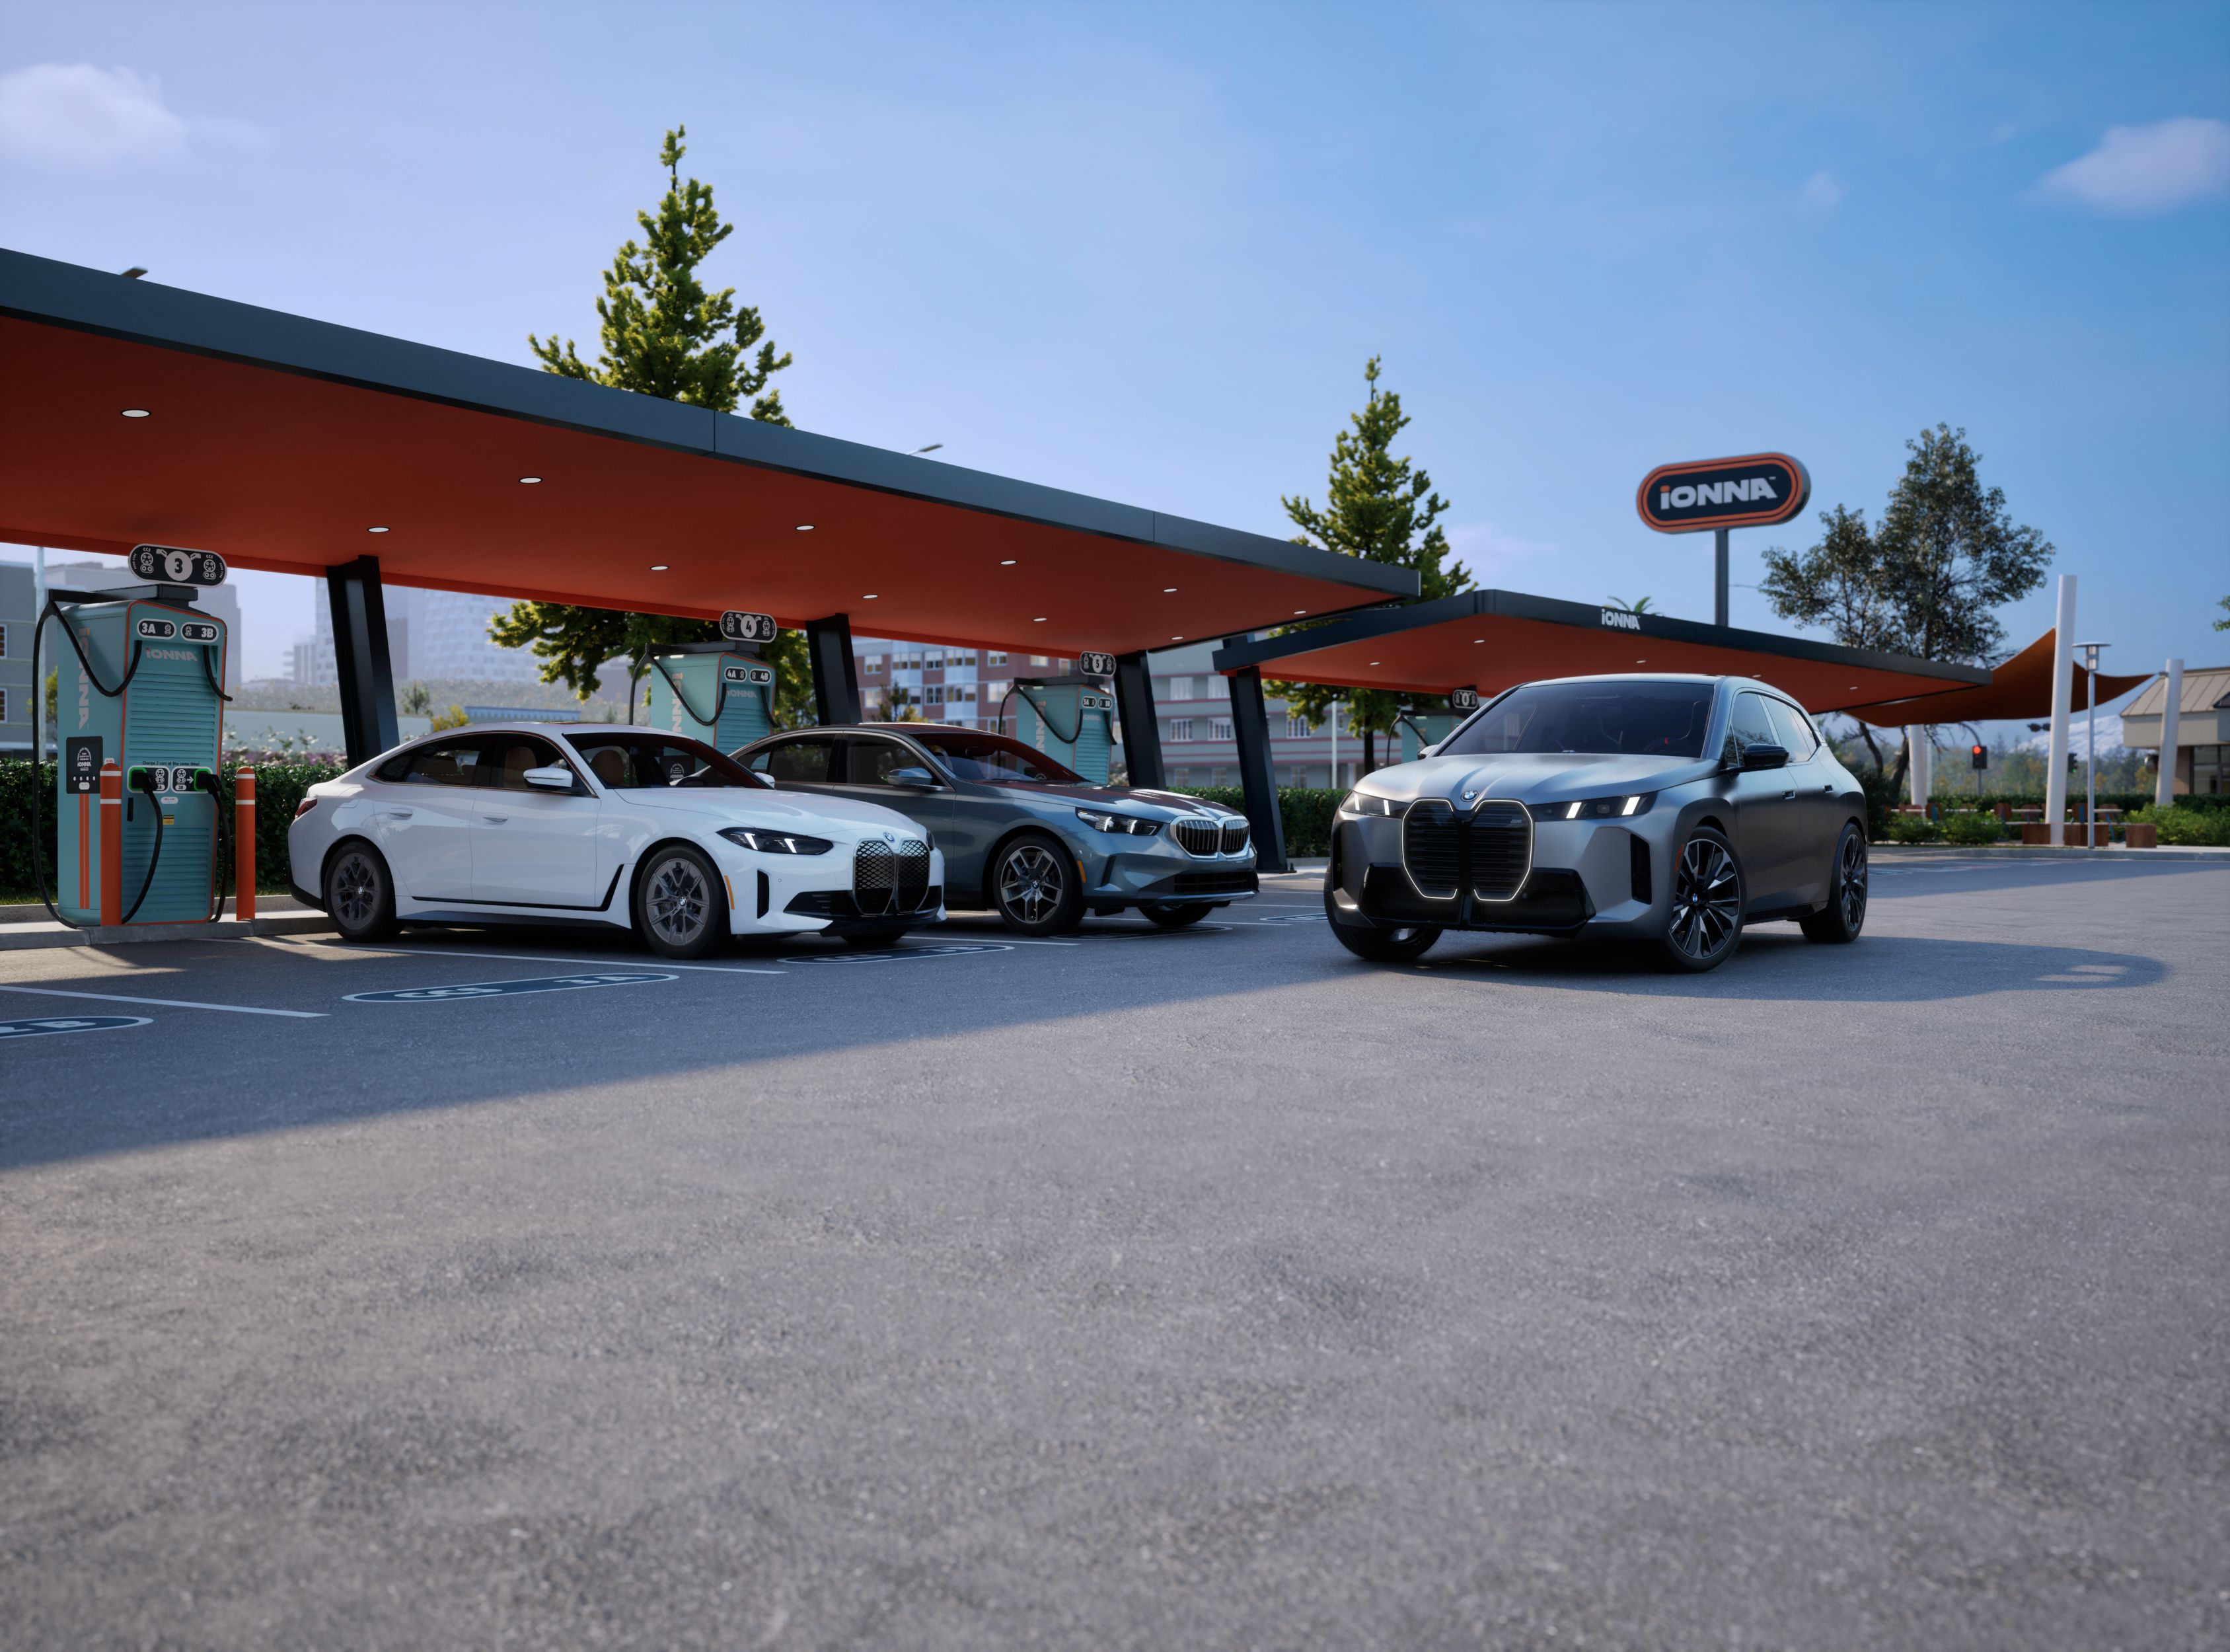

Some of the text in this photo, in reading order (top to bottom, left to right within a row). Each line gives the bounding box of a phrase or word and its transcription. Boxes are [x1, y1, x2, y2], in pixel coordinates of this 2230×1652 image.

[174, 558, 183, 574] 3
[141, 622, 156, 634] 3A
[746, 620, 752, 632] 4
[201, 627, 213, 638] 3B
[1096, 659, 1099, 668] 5
[727, 669, 736, 679] 4A
